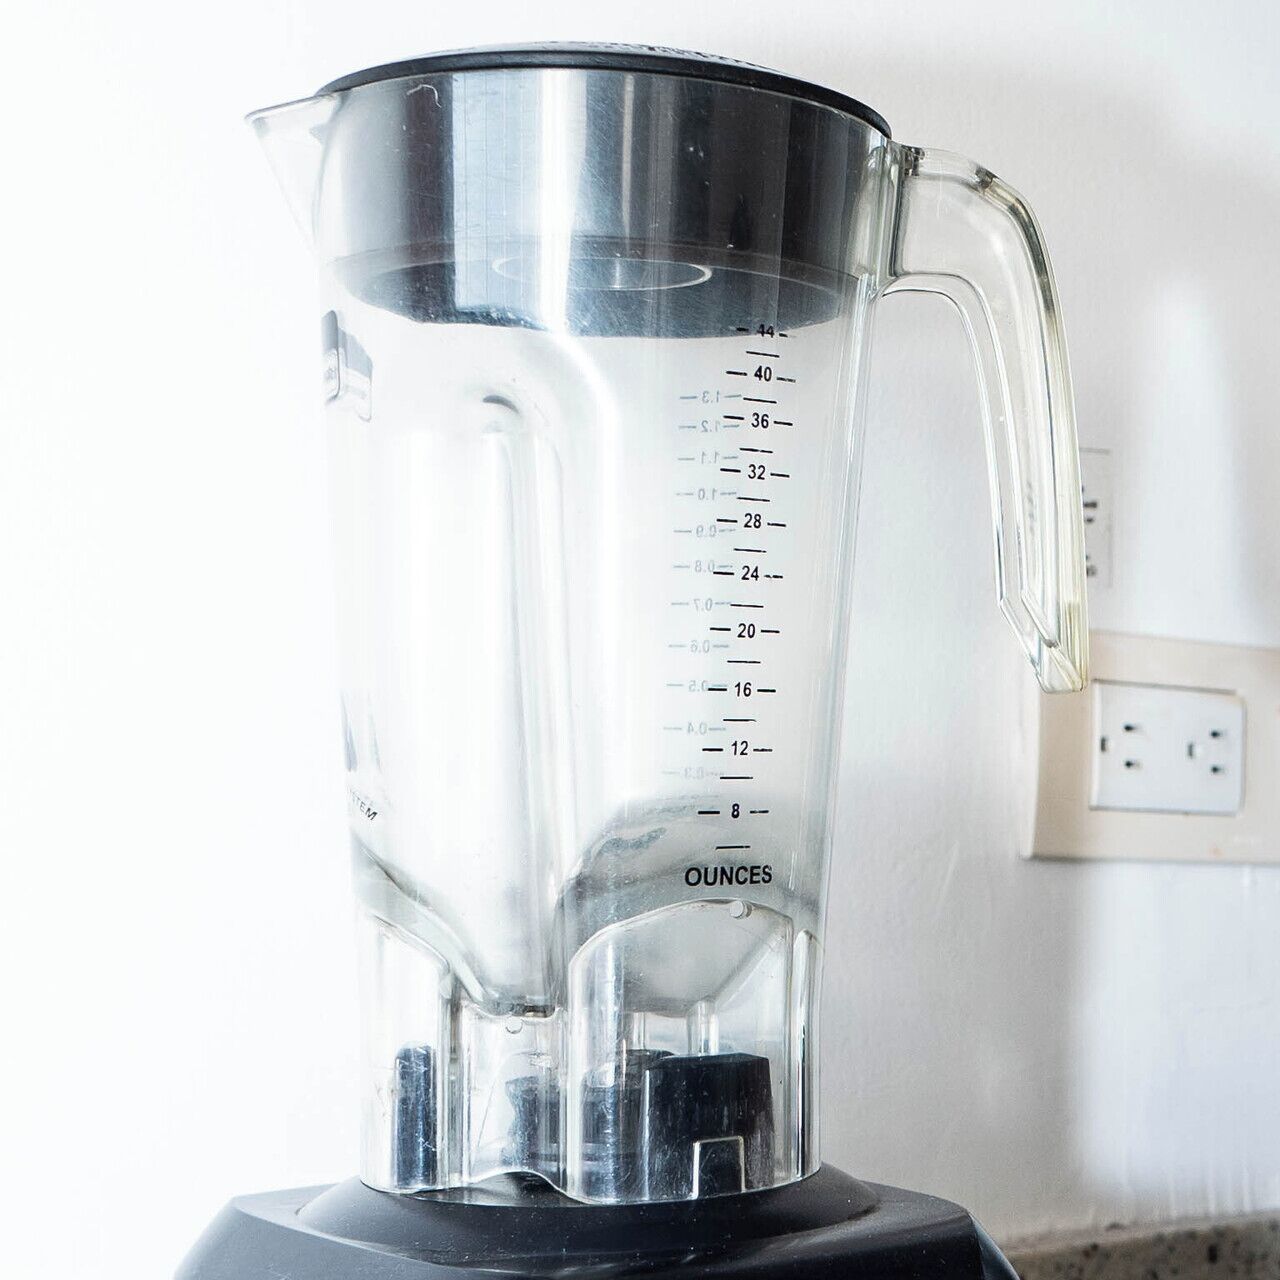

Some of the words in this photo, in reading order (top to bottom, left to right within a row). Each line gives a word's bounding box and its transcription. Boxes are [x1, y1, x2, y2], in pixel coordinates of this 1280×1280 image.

[757, 323, 776, 338] 44
[754, 365, 772, 382] 40
[751, 412, 770, 429] 36
[747, 464, 766, 480] 32
[743, 512, 762, 529] 28
[741, 565, 760, 581] 24
[737, 622, 756, 639] 20
[734, 681, 752, 698] 16
[730, 740, 749, 756] 12
[731, 803, 740, 819] 8
[684, 864, 773, 887] OUNCES
